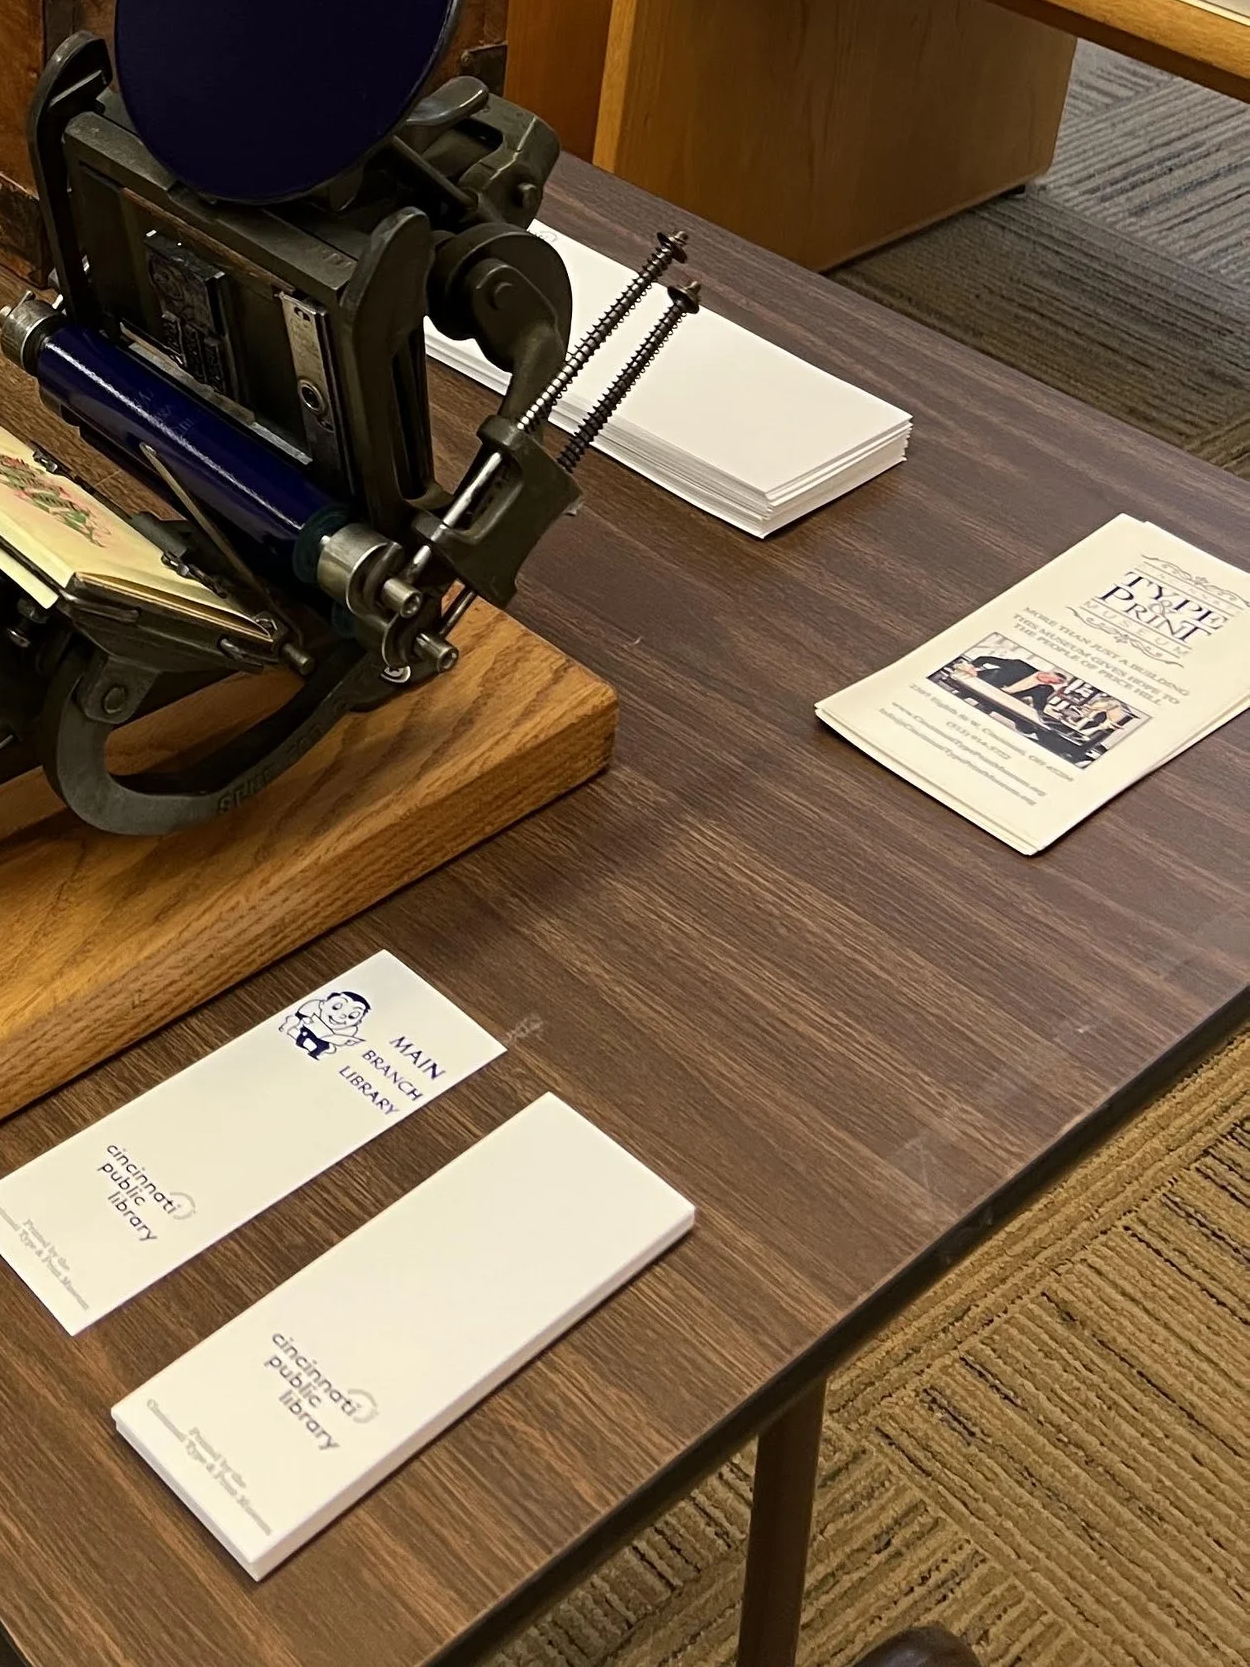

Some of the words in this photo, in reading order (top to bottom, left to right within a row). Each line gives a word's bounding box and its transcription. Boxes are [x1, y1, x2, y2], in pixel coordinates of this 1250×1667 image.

[1083, 600, 1190, 657] MUSEUM
[1096, 583, 1212, 643] PRINT
[1124, 571, 1229, 631] TYPE
[1149, 599, 1177, 616] &
[1013, 623, 1037, 638] THE
[1036, 635, 1081, 662] PEOPLE
[1080, 660, 1099, 670] OF
[1098, 669, 1134, 690] PRICE
[1013, 613, 1038, 630] THIS
[1039, 628, 1094, 661] MUSEUM
[1090, 656, 1126, 678] GIVES
[1162, 694, 1180, 705] TO
[1023, 606, 1059, 627] MORE
[1058, 625, 1091, 649] THAN
[1089, 643, 1120, 660] JUST
[1130, 663, 1190, 696] BUILDING
[361, 1049, 424, 1102] BRANCH
[389, 1036, 447, 1081] MAIN
[338, 1065, 401, 1115] LIBRARY
[96, 1162, 146, 1206] public
[106, 1144, 181, 1215] cincinnati
[107, 1190, 158, 1242] library
[263, 1354, 322, 1409] public
[272, 1333, 362, 1417] cincinnati
[278, 1389, 341, 1451] library
